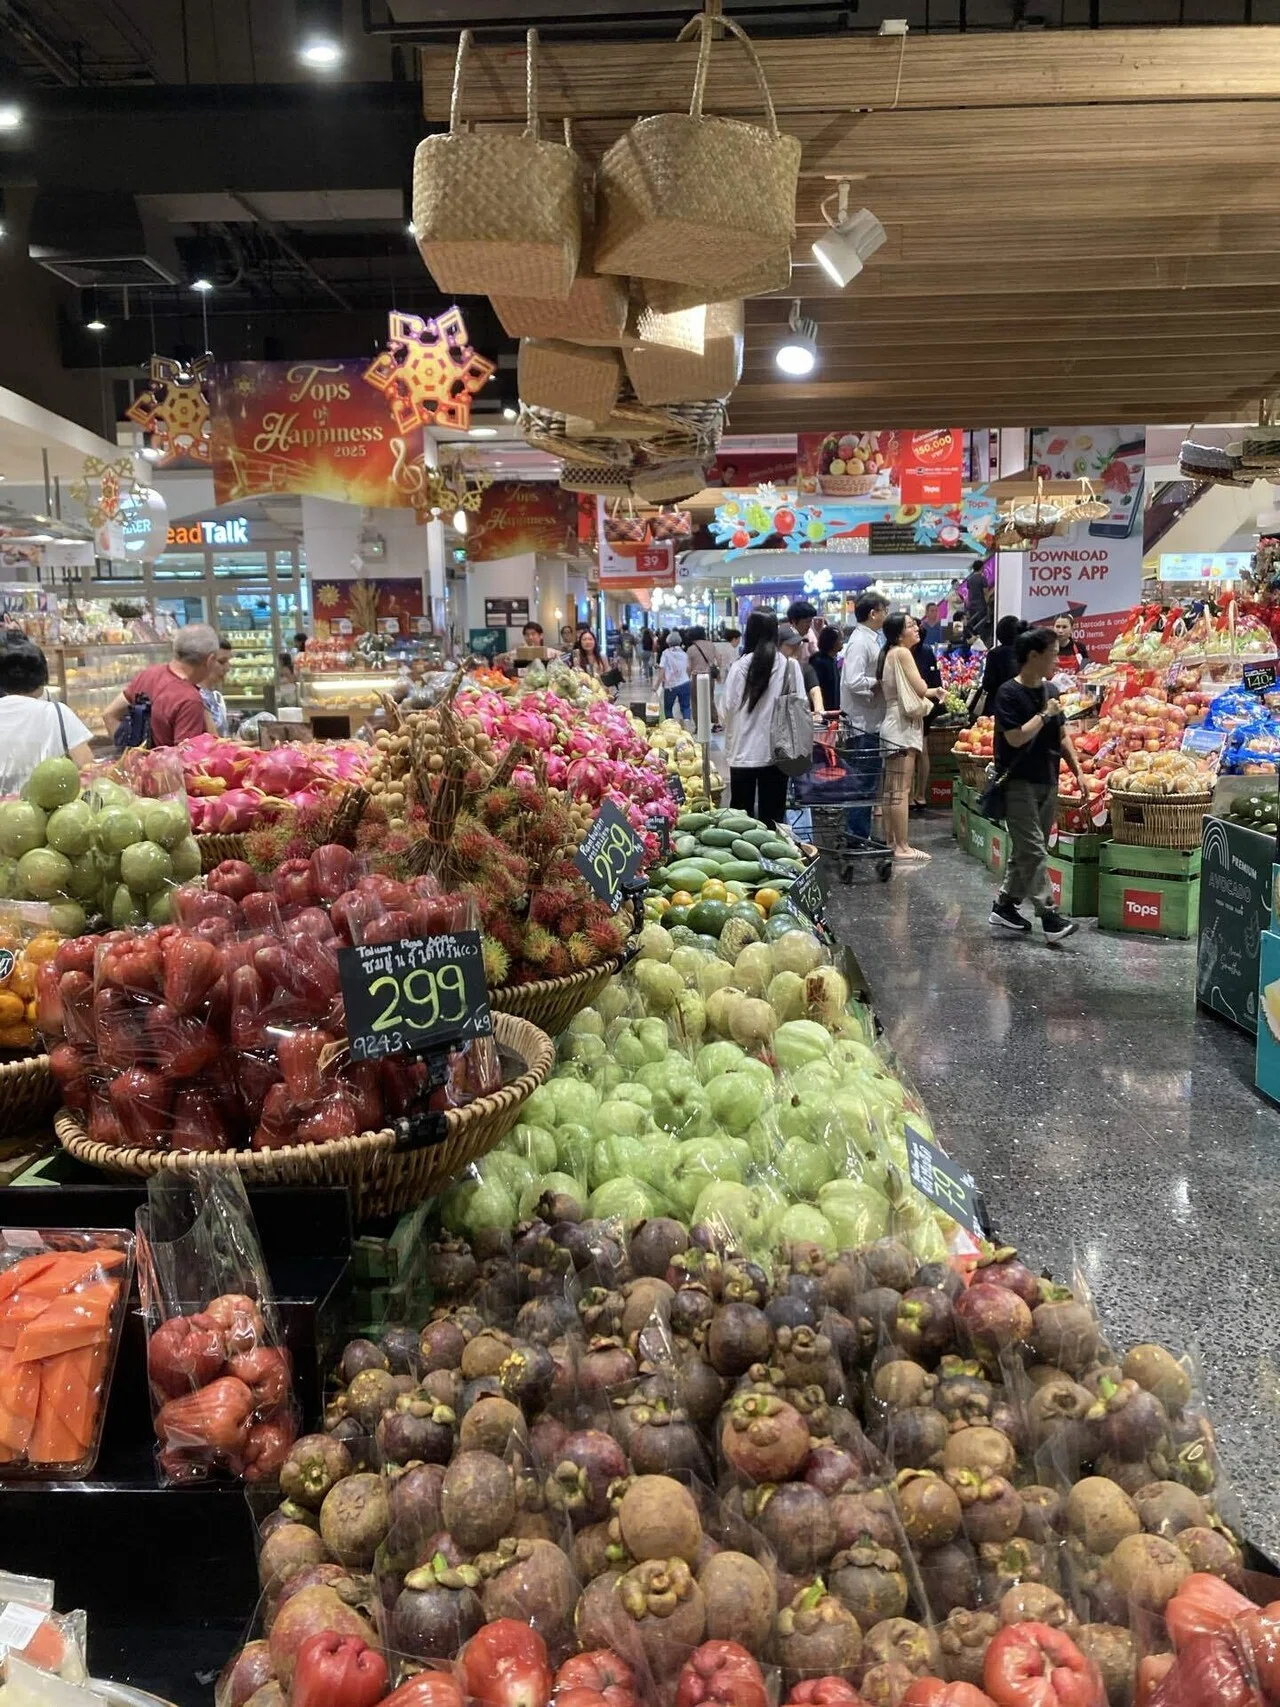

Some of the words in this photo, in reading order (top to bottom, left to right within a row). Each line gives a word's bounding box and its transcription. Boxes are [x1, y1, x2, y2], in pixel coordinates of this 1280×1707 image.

[287, 363, 350, 402] Tops
[253, 411, 384, 453] Happiness
[333, 444, 367, 458] 2025
[914, 434, 952, 456] 150,000
[967, 499, 990, 508] Tops
[165, 518, 248, 545] eadTalk
[643, 555, 659, 567] 39
[1029, 550, 1108, 562] DOWNLOAD
[1029, 566, 1072, 581] TOPS
[1078, 566, 1109, 580] APP
[1029, 585, 1069, 597] NOW!
[1071, 629, 1085, 639] 00
[1080, 620, 1105, 629] barcode
[931, 787, 951, 796] Tops
[579, 817, 604, 857] Rambutan
[971, 829, 985, 848] Tops
[594, 823, 632, 895] 259
[1232, 854, 1257, 880] PREMIUM
[1208, 871, 1251, 903] AVOCADO
[1126, 901, 1159, 916] Tops
[368, 964, 468, 1031] 299
[931, 1165, 968, 1216] 79
